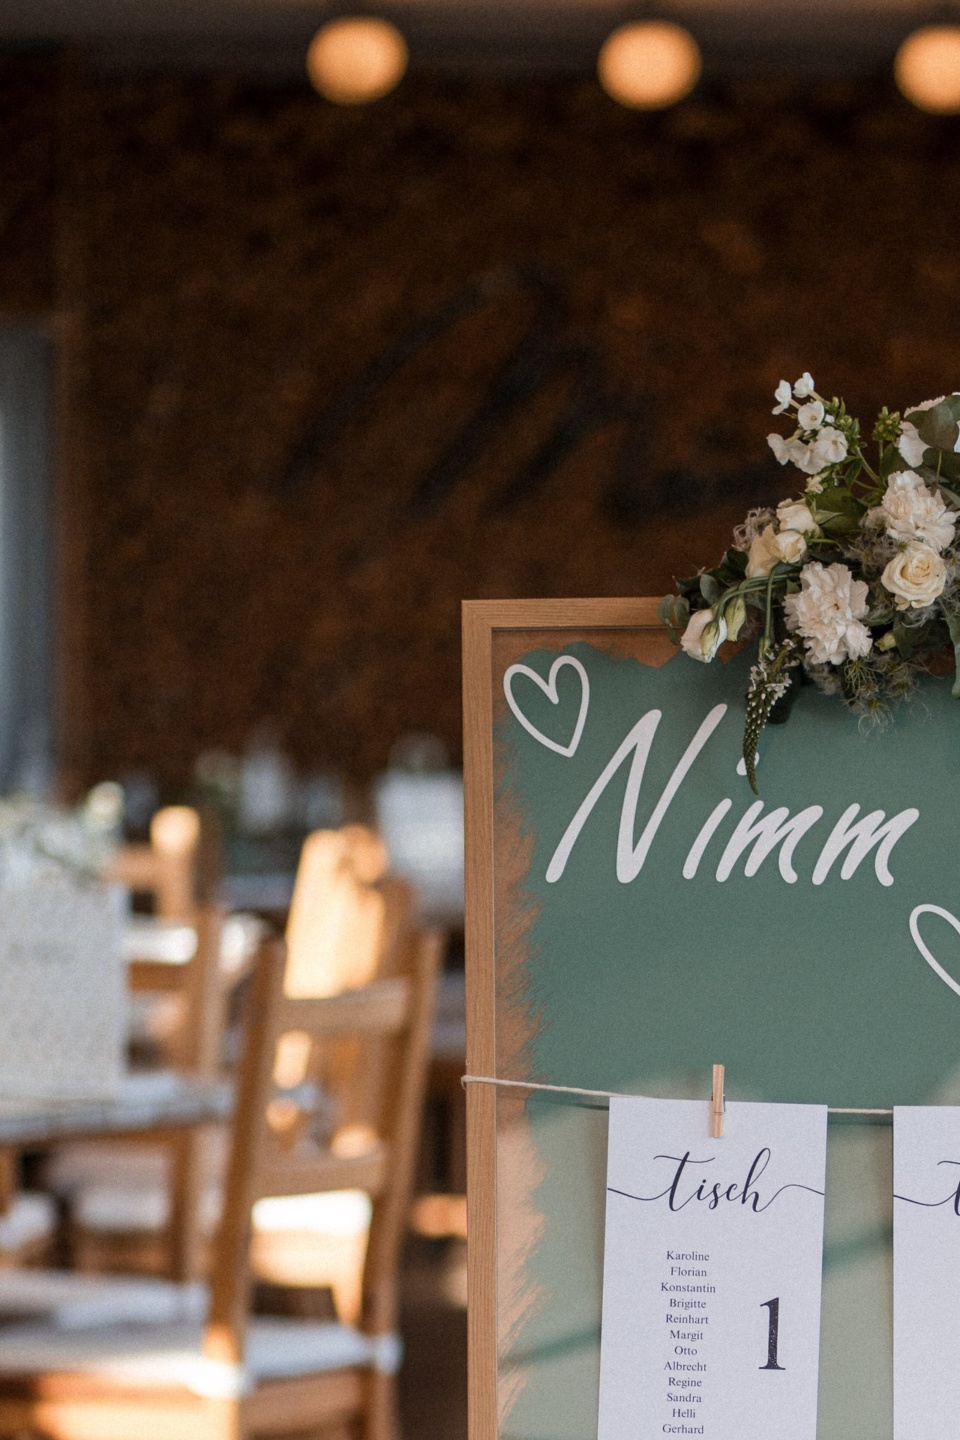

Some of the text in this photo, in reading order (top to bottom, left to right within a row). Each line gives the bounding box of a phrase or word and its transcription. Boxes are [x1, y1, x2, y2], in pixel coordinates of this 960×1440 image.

[544, 701, 921, 887] Nimm
[666, 1250, 710, 1262] Karoline
[670, 1266, 707, 1277] Florian
[660, 1282, 716, 1294] Konstantin
[669, 1298, 707, 1311] Brigitte
[665, 1313, 709, 1325] Reinhart
[669, 1329, 703, 1343] Margit
[759, 1297, 785, 1370] 1
[674, 1345, 698, 1356] Otto
[663, 1361, 707, 1372] Albrecht
[668, 1376, 703, 1389] Regine
[666, 1392, 702, 1403] Sandra
[672, 1408, 696, 1419] Helli
[662, 1423, 704, 1435] Gerhard
